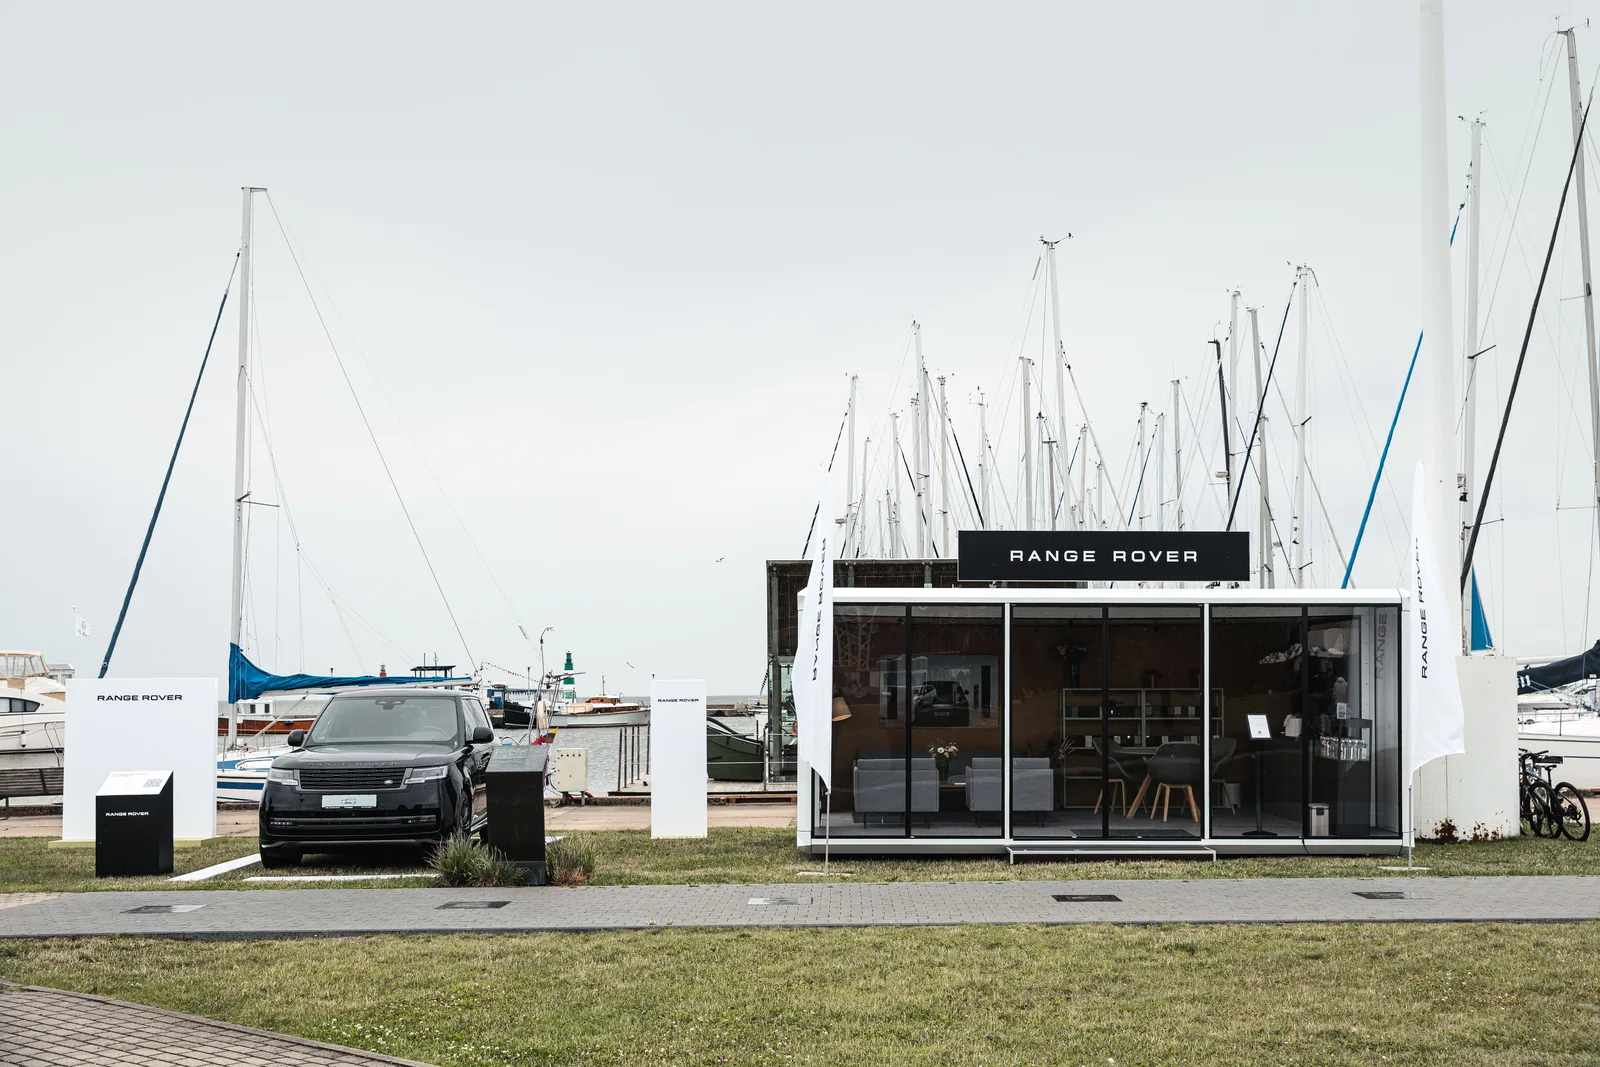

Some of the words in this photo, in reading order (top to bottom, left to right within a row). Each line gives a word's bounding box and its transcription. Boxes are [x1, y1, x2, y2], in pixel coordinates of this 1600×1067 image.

[1009, 549, 1096, 562] RANGE
[1112, 550, 1198, 563] ROVER
[1415, 537, 1424, 603] ROVER
[1420, 608, 1428, 679] RANGE
